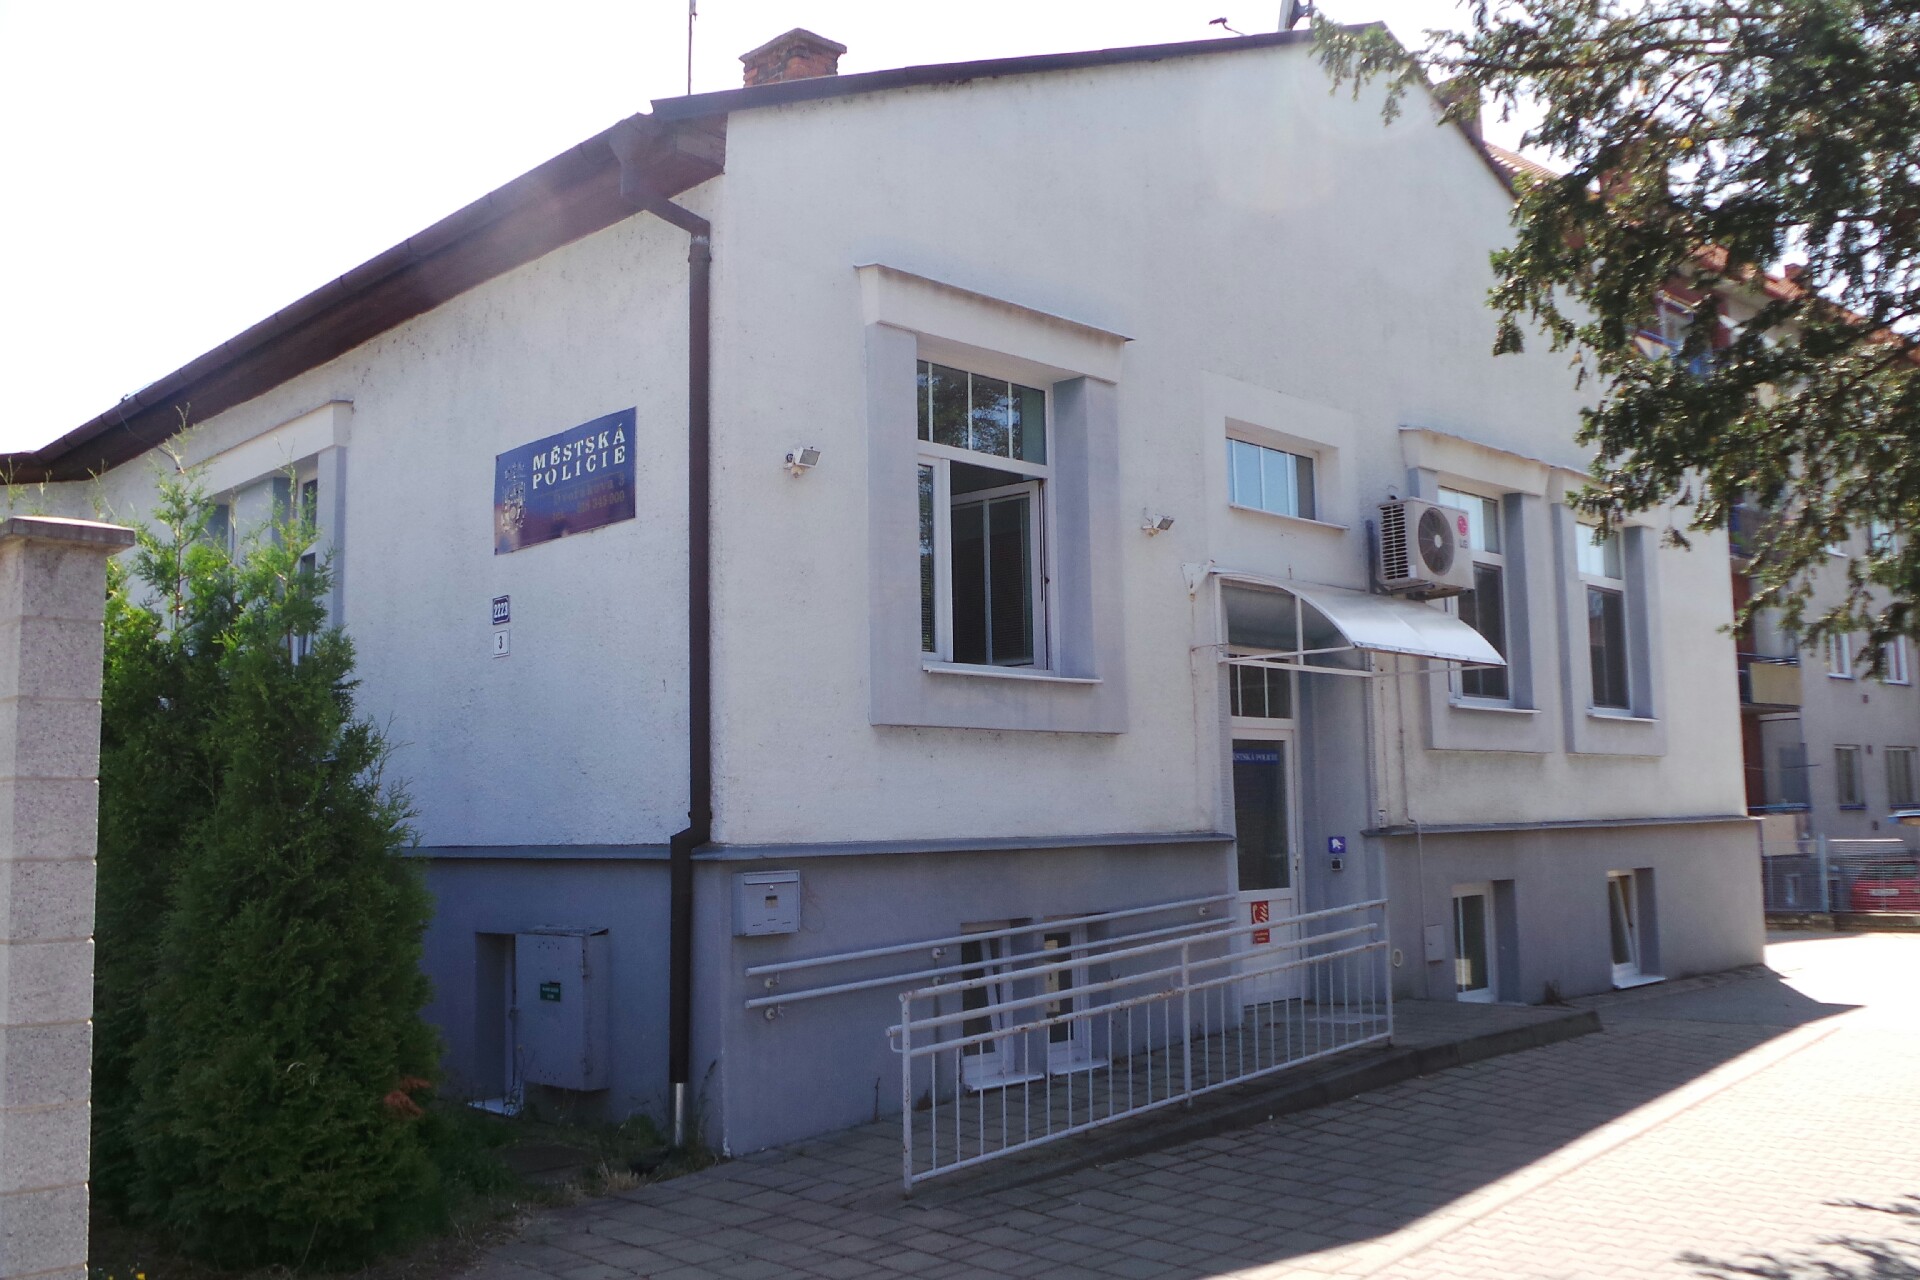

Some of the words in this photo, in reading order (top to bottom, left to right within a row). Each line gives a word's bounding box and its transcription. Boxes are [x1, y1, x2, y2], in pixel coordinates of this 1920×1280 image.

[532, 423, 626, 472] MĚSTSKÁ
[532, 445, 626, 489] POLICIE
[494, 601, 508, 618] 2223
[498, 635, 503, 650] 3
